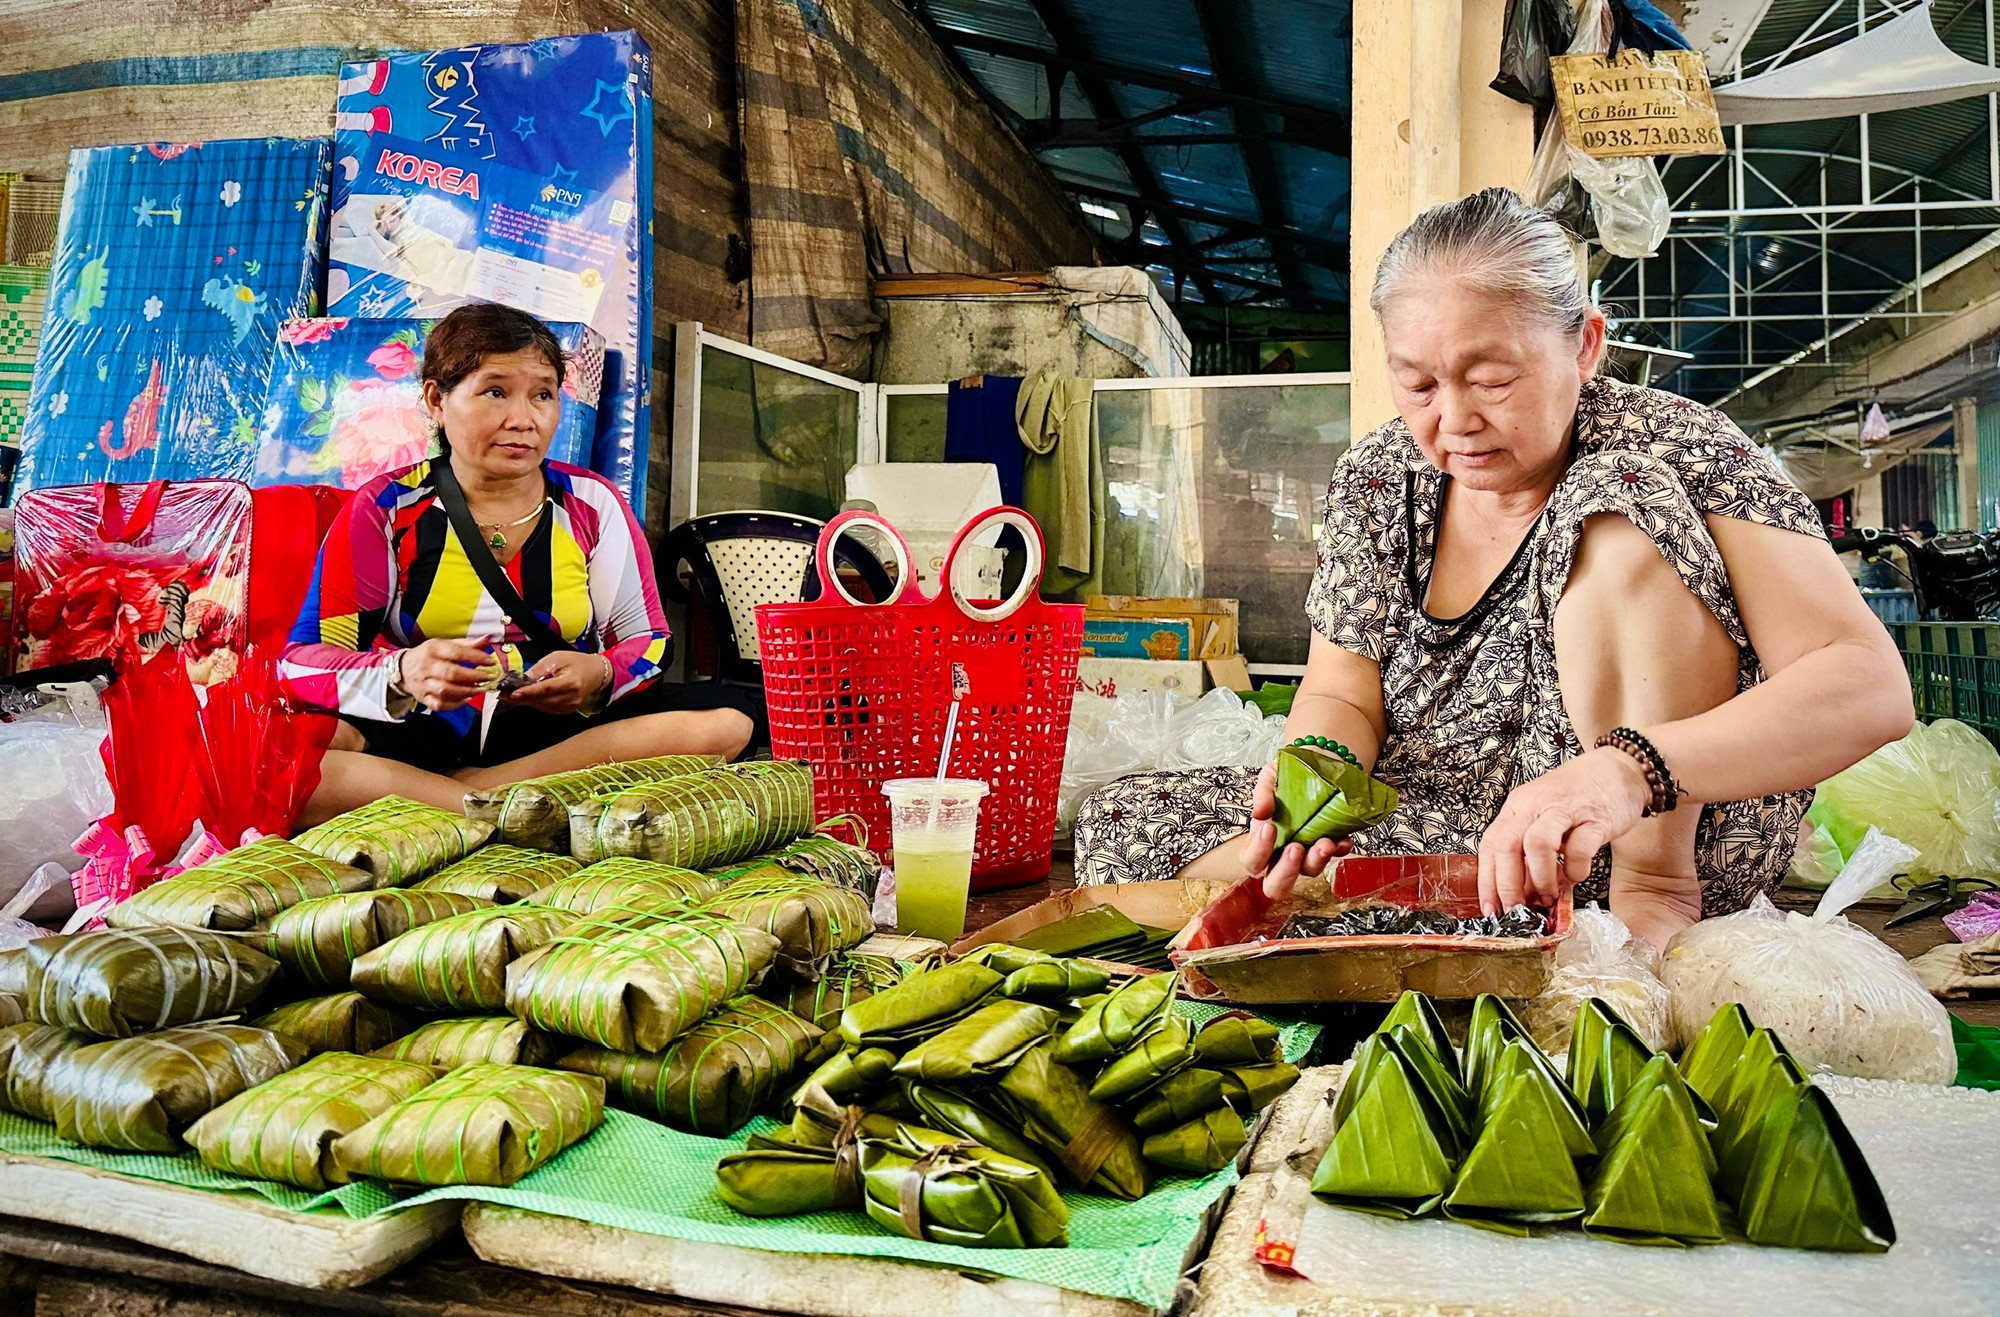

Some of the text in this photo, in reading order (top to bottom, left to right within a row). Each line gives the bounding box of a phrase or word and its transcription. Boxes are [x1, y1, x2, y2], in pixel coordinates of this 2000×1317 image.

[1573, 77, 1629, 96] BÁNH
[1578, 106, 1601, 121] Cô
[1606, 100, 1637, 118] Bốn
[1582, 127, 1719, 148] 0938.73.03.86
[375, 148, 480, 201] KOREA
